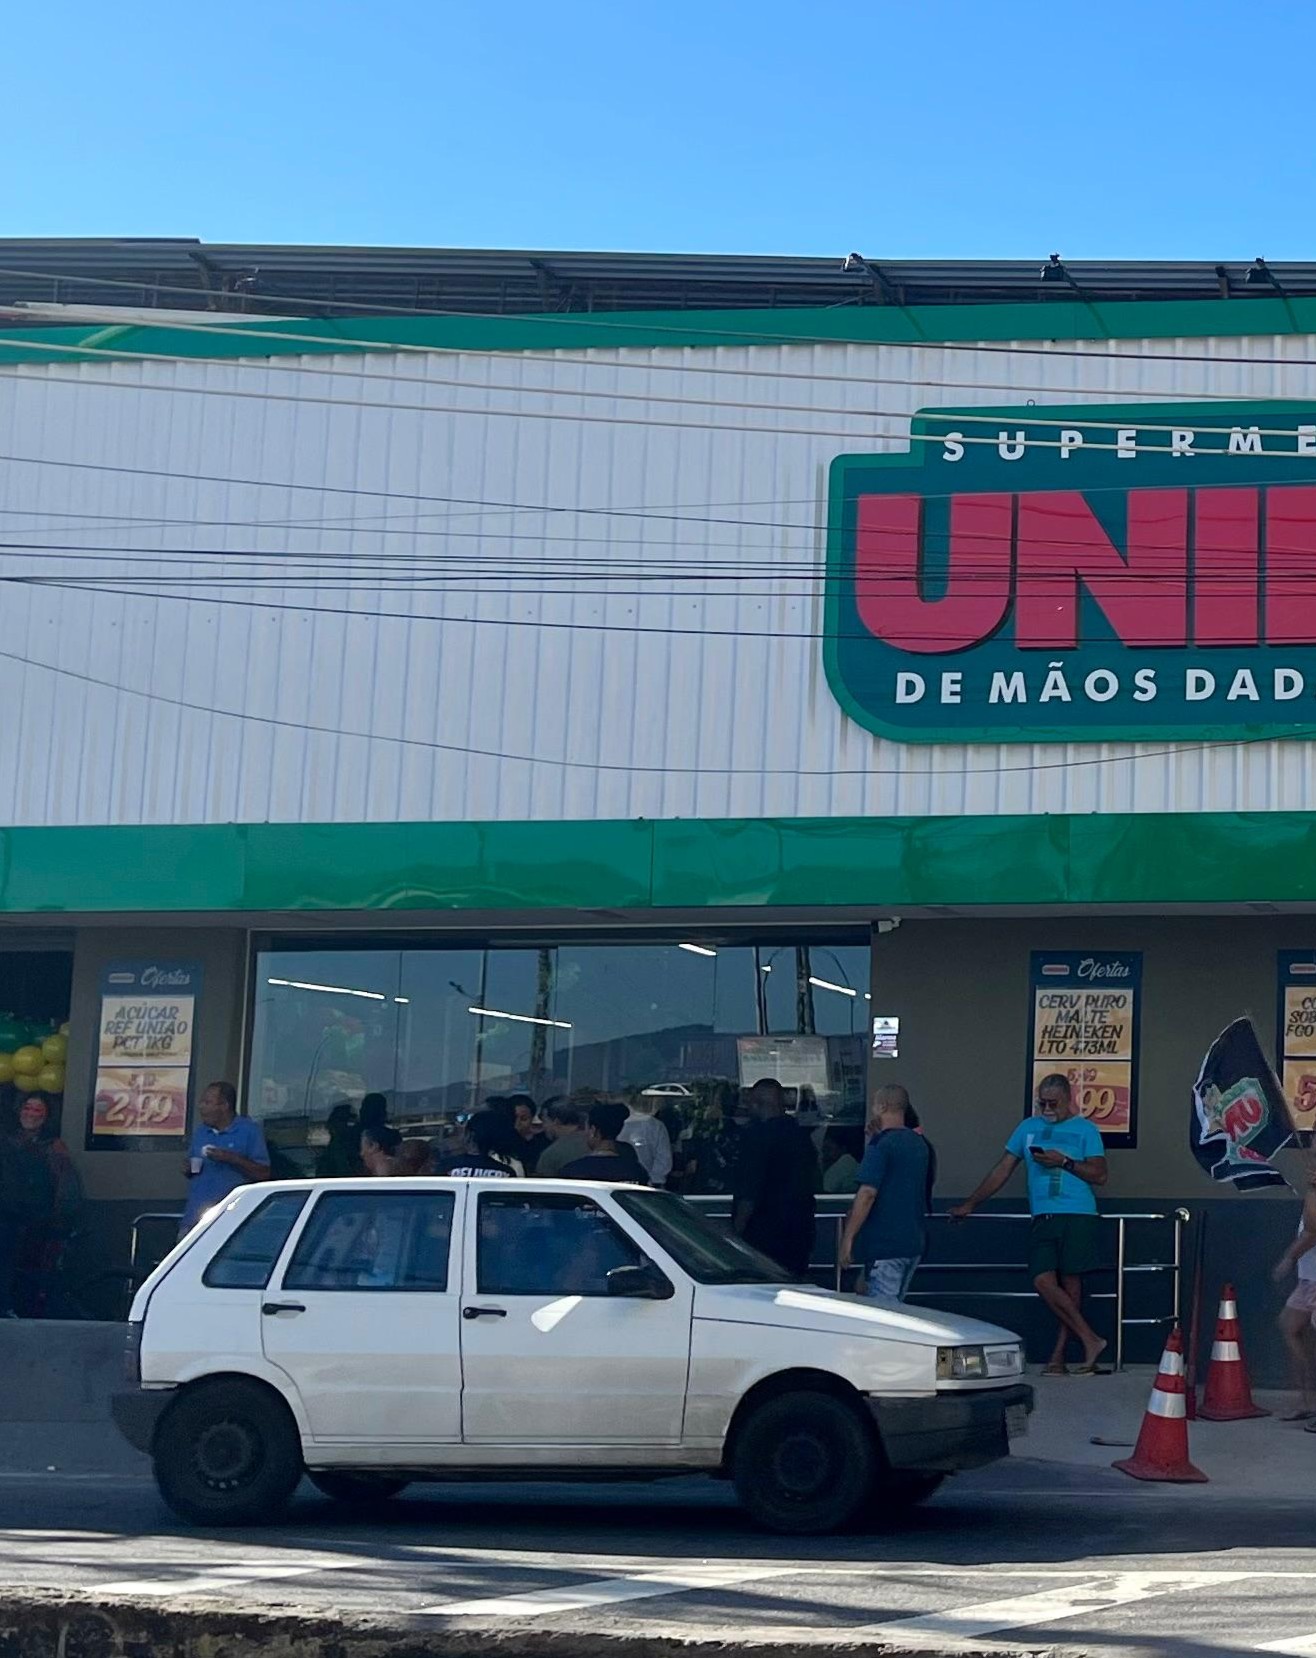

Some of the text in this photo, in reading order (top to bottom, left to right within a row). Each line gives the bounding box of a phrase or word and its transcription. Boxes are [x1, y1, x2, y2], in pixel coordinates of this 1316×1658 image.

[895, 671, 963, 704] DE
[988, 661, 1158, 703] MÃOS
[141, 966, 190, 988] Ofertas
[1077, 958, 1131, 981] Ofertas
[1041, 1024, 1124, 1039] HEINEKEN
[1038, 1040, 1067, 1054] LTO
